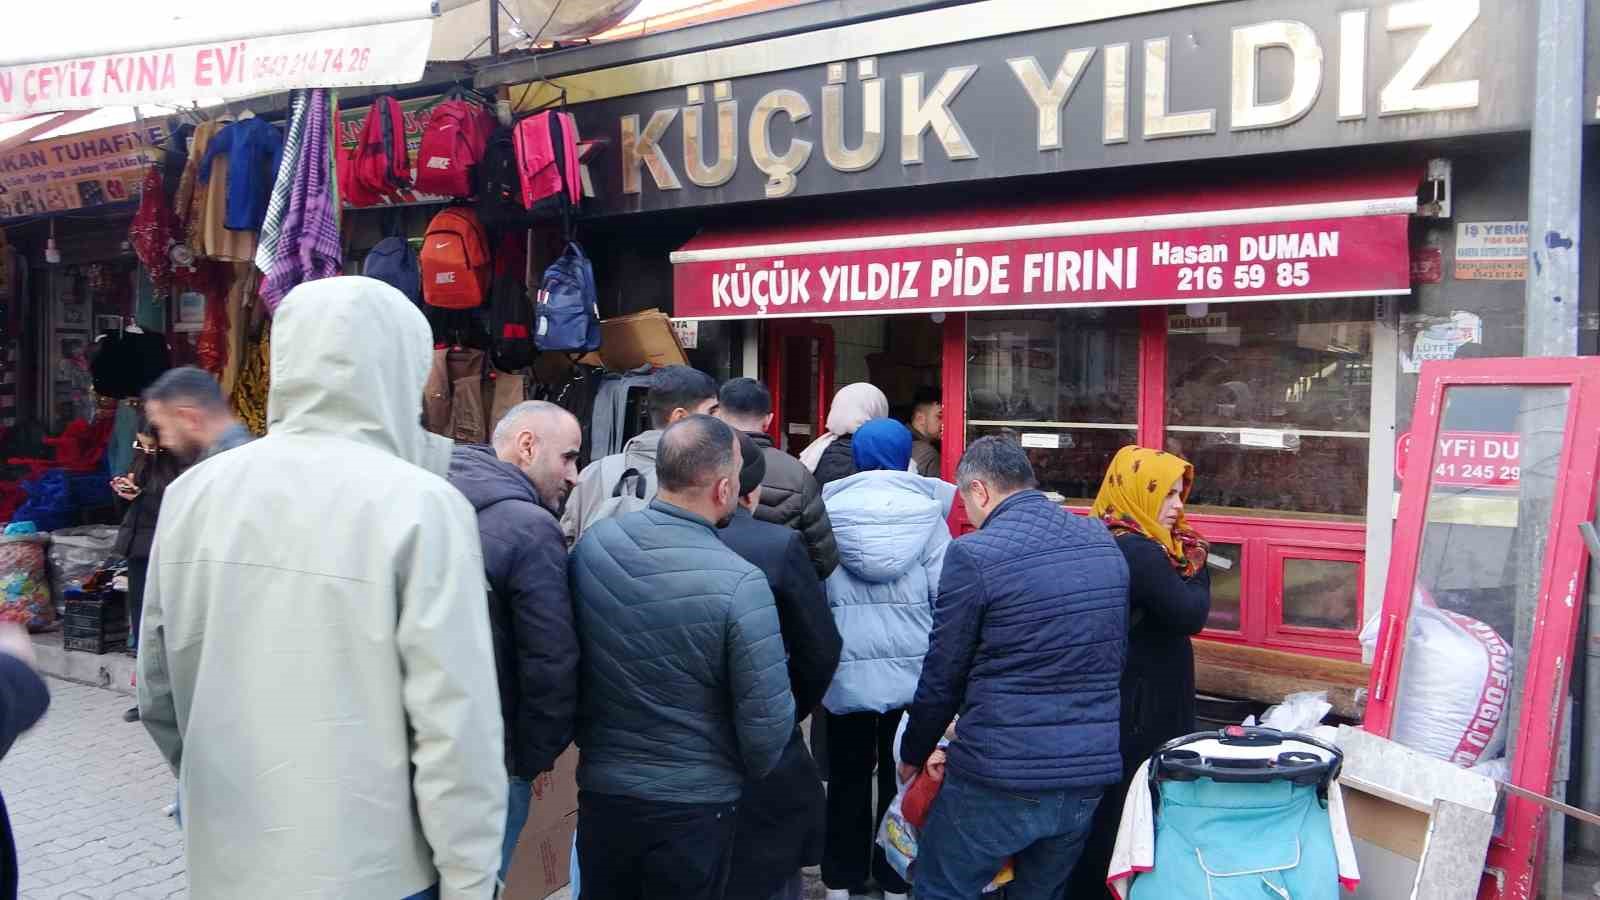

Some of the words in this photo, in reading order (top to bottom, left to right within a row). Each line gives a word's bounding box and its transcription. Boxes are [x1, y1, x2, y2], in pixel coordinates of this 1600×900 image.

[104, 53, 175, 93] KINA
[321, 48, 343, 72] 74
[349, 47, 371, 71] 26
[620, 57, 979, 199] KÜÇÜK
[1007, 0, 1480, 152] YILDIZ
[1152, 241, 1228, 266] Hasan
[1239, 231, 1340, 261] DUMAN
[711, 260, 811, 315] KÜÇÜK
[818, 261, 922, 304] YILDIZ
[930, 247, 1010, 298] PİDE
[1023, 246, 1138, 293] FIRINI
[1176, 266, 1223, 291] 216
[1233, 264, 1265, 289] 59
[1276, 262, 1310, 287] 85
[1435, 463, 1455, 477] 41
[1461, 464, 1494, 479] 245
[1500, 466, 1520, 481] 29
